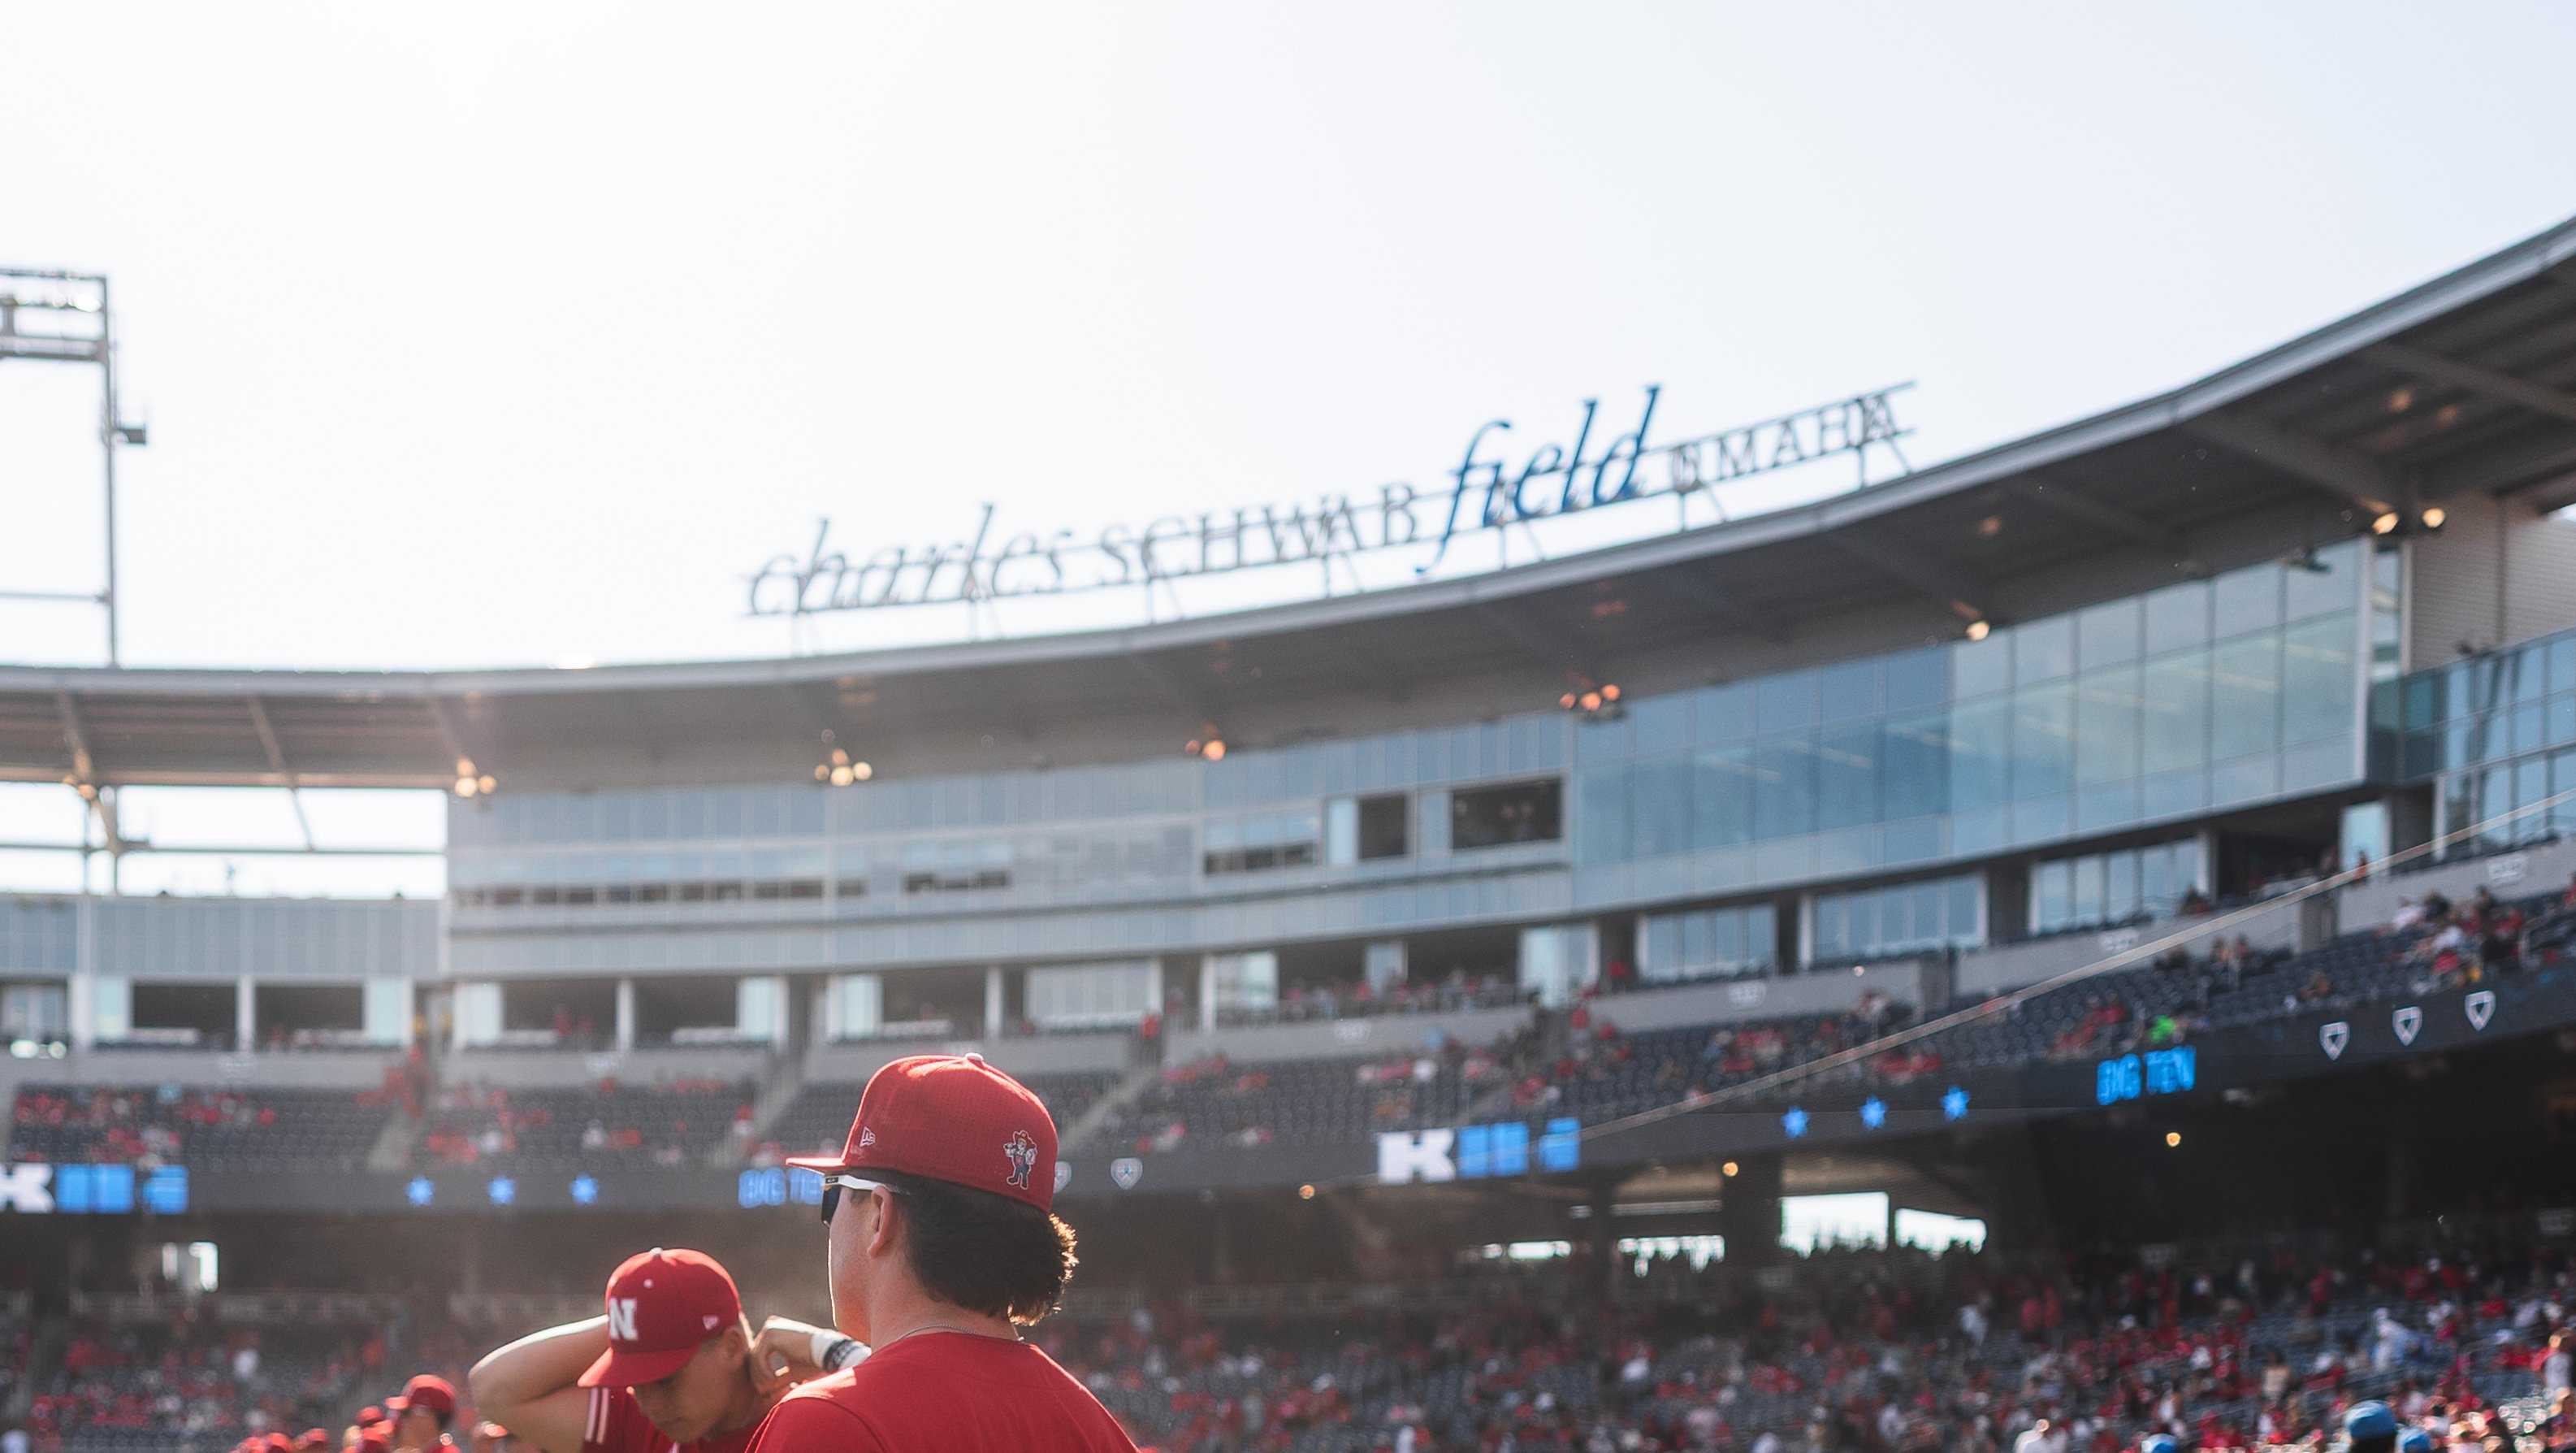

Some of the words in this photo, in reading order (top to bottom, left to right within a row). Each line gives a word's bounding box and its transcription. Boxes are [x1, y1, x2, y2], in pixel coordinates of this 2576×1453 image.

[749, 500, 1075, 616] charles
[1098, 481, 1418, 585] SCHWAB
[1414, 384, 1663, 575] field
[1669, 393, 1898, 488] OMAHA
[609, 1298, 638, 1341] N
